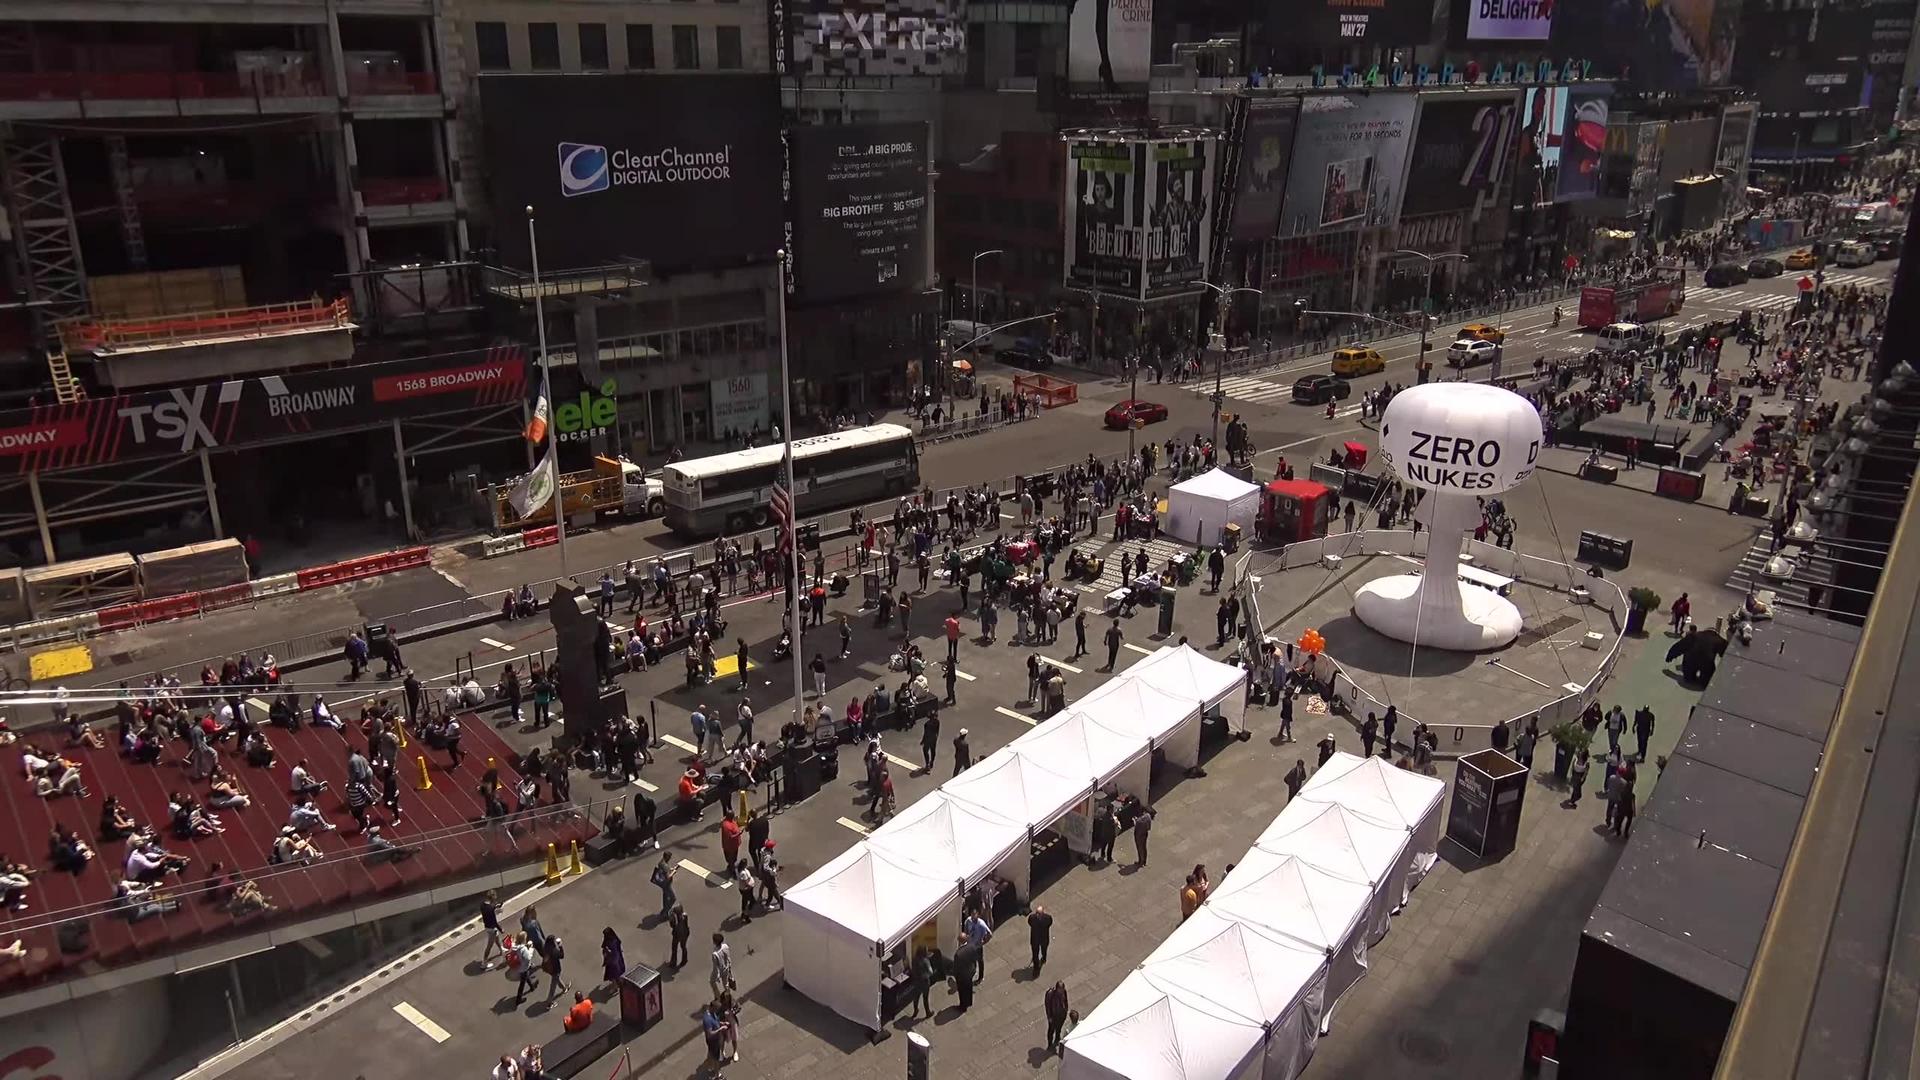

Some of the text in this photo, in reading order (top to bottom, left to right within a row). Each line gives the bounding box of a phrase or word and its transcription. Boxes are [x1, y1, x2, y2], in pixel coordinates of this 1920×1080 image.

[1122, 9, 1151, 22] CRIME
[774, 0, 785, 72] XPRESS
[1341, 24, 1366, 36] MAY 27
[874, 144, 890, 155] BIG
[613, 166, 731, 184] DIGITAL OUTDOOR
[823, 206, 841, 218] BIG
[397, 367, 503, 392] 1568 BROADWAY
[269, 385, 356, 417] BROADWAY
[556, 378, 617, 433] elé
[118, 384, 219, 453] TSX
[559, 427, 606, 442] OCCER
[1408, 430, 1500, 468] ZERO
[1407, 462, 1496, 489] NUKES
